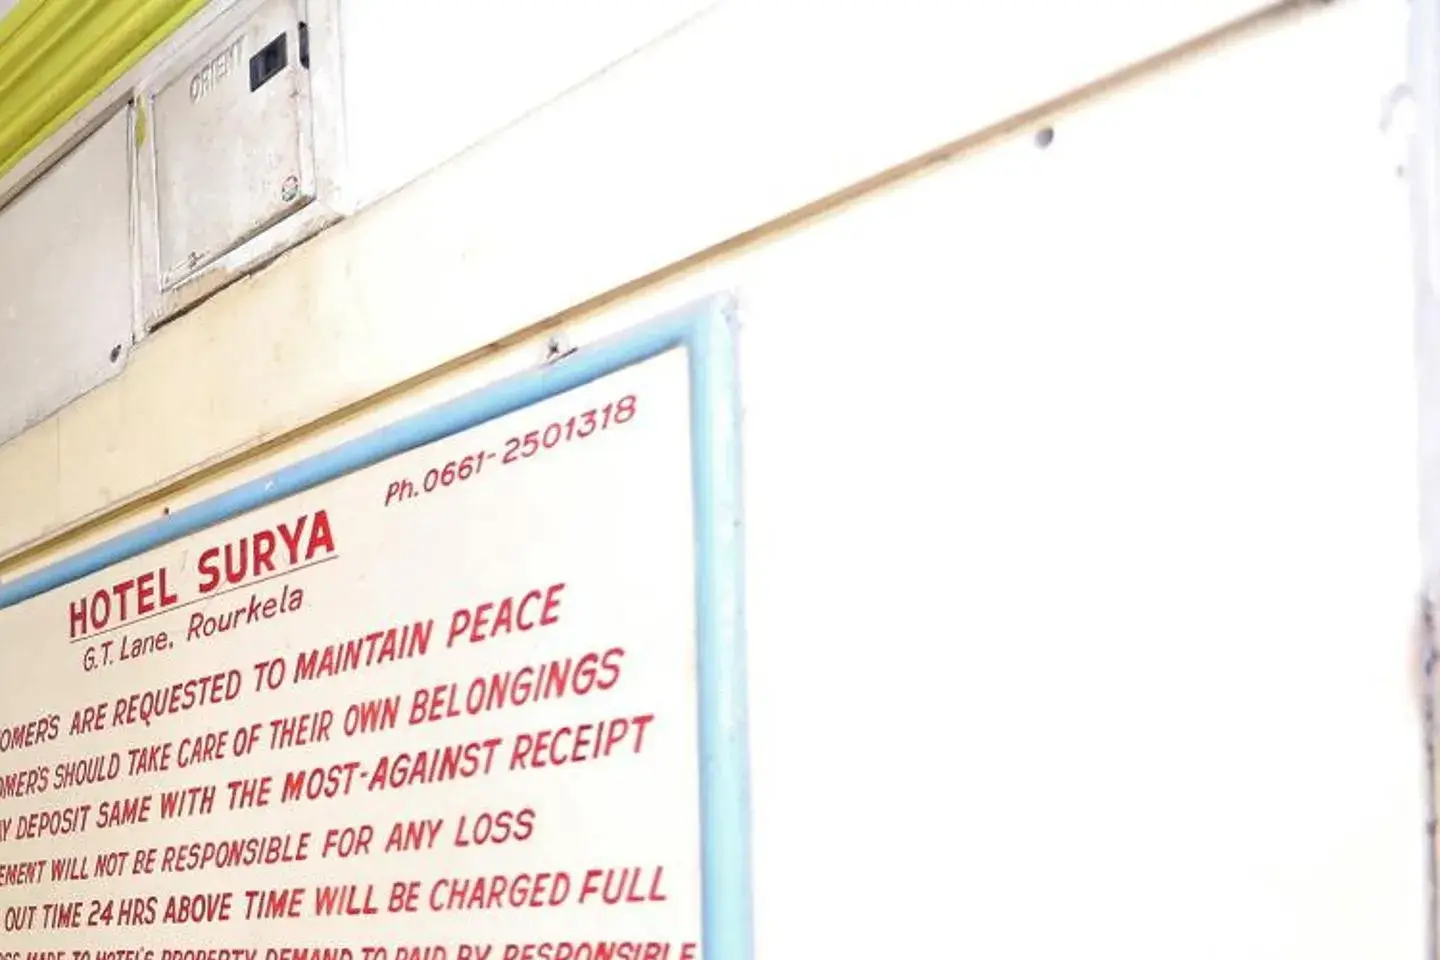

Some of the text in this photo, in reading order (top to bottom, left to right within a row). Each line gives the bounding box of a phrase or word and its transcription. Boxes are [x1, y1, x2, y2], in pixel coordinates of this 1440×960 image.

[68, 508, 336, 639] HOTEL SURYA
[186, 584, 305, 643] Rourkela
[52, 751, 121, 791] SHOULD
[127, 741, 174, 777] TAKE
[176, 729, 230, 769] CARE
[231, 722, 264, 758] OF
[268, 708, 335, 751] THEIR
[342, 694, 402, 738] OWN
[407, 646, 626, 726] BELONGINGS
[68, 701, 109, 737] ARE
[111, 668, 243, 728] REQUESTED
[253, 656, 287, 693] TO
[292, 618, 435, 685] MAINTAIN
[445, 581, 566, 649] PEACE
[14, 803, 93, 841] DEPOSIT
[95, 794, 153, 830] SAME
[160, 784, 217, 820] WITH
[226, 775, 274, 812] THE
[508, 713, 655, 772] RECEIPT
[3, 905, 38, 933] OUT
[42, 901, 84, 930] TIME
[86, 899, 115, 928] 24
[116, 895, 159, 927] HRS
[161, 891, 234, 925] ABOVE
[244, 887, 307, 921] TIME
[314, 883, 380, 917] WILL
[386, 880, 422, 914] BE
[428, 870, 572, 913] CHARGED
[577, 864, 667, 906] FULL
[50, 855, 90, 883] WILL
[93, 850, 131, 878] NOT
[131, 847, 158, 876] BE
[160, 831, 313, 873] RESPONSIBLE
[320, 823, 375, 859] FOR
[383, 817, 445, 854] ANY
[453, 807, 537, 849] LOSS
